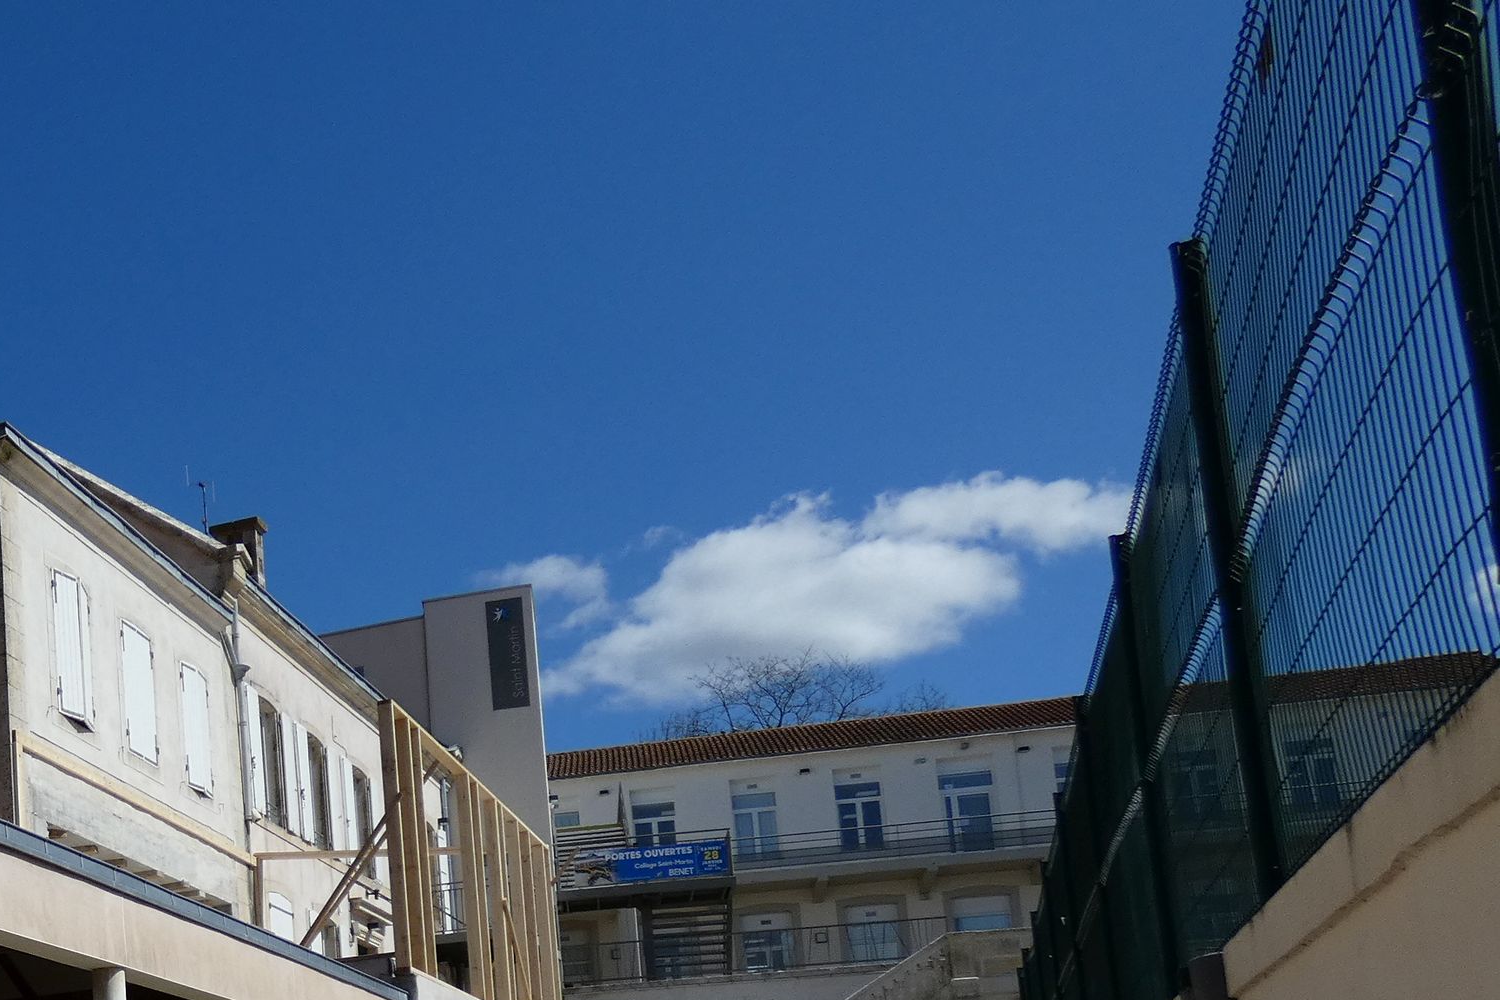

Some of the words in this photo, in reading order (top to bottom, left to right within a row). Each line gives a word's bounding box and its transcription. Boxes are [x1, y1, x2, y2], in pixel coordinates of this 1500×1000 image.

[605, 853, 642, 862] PORTES
[643, 846, 693, 858] OUVERTES
[704, 850, 719, 860] 28
[668, 867, 694, 877] BENET
